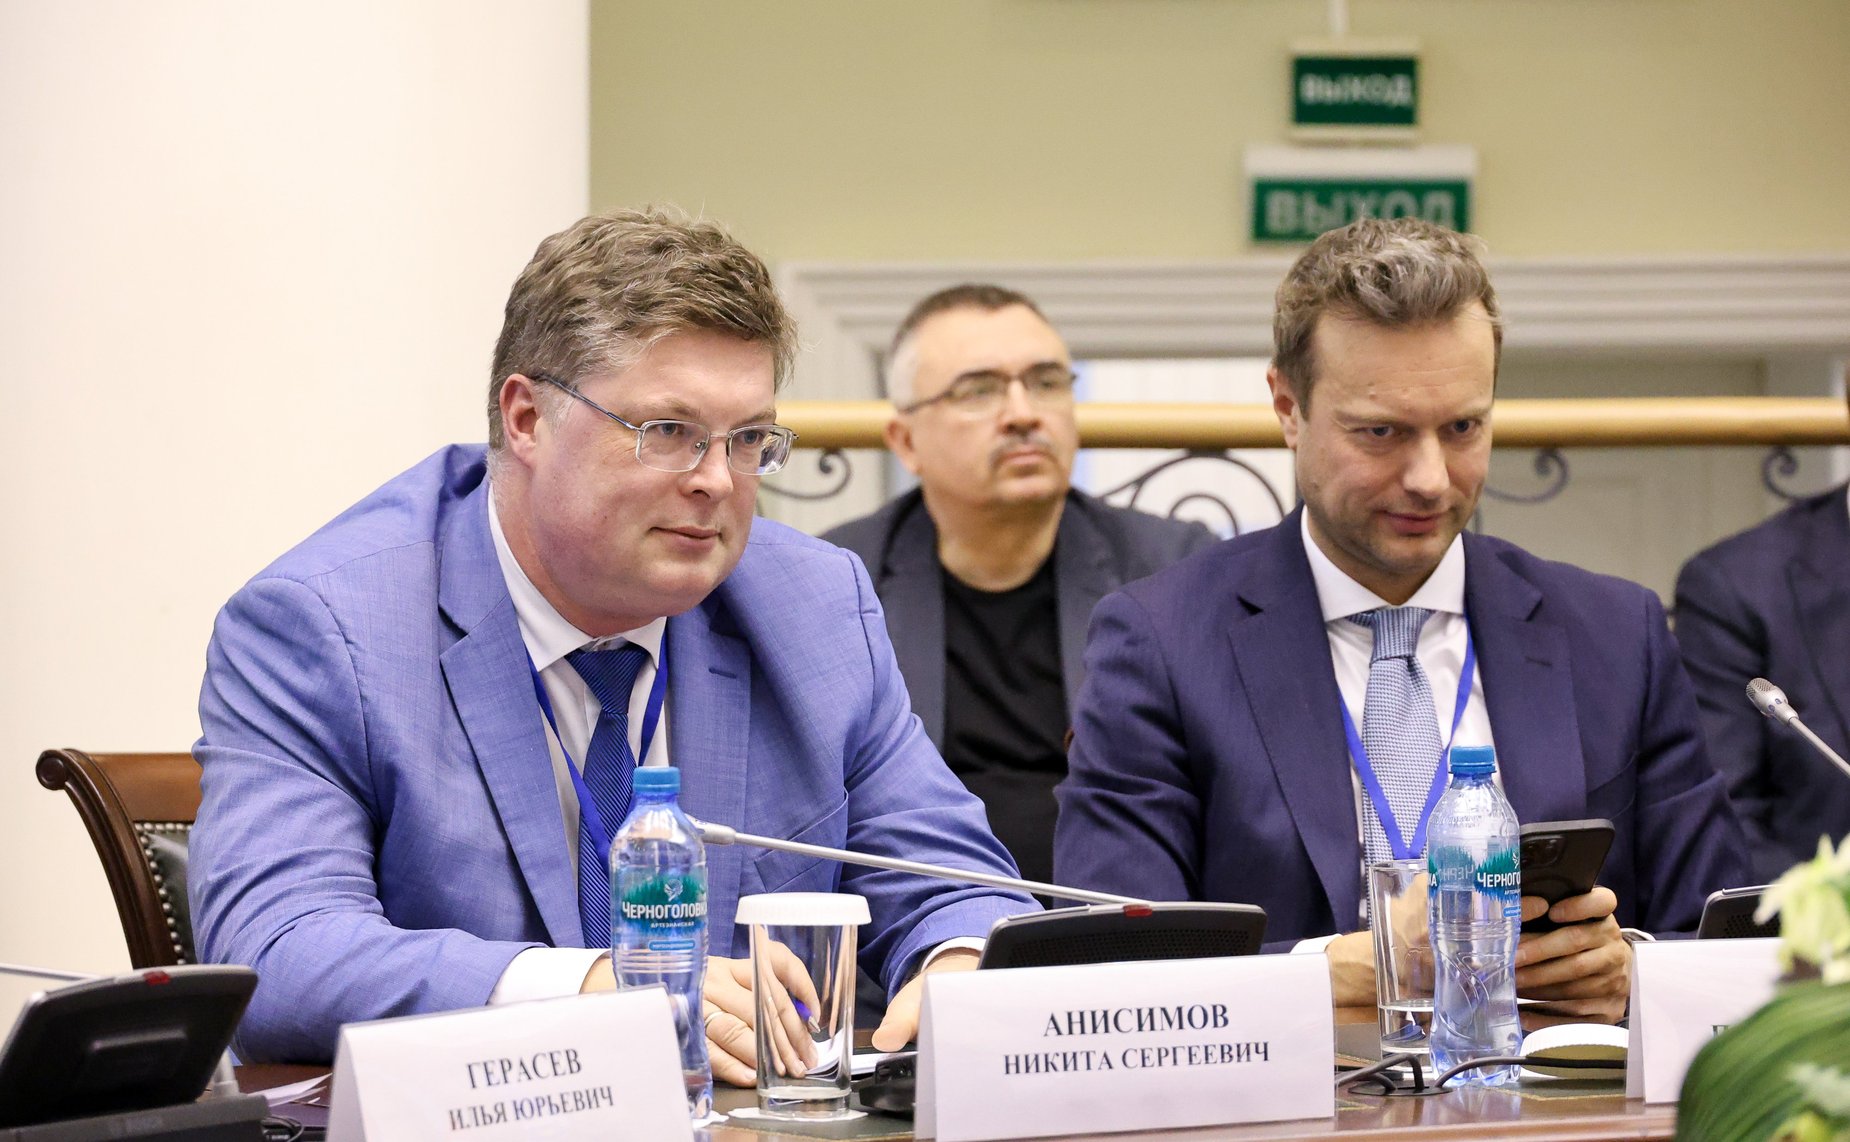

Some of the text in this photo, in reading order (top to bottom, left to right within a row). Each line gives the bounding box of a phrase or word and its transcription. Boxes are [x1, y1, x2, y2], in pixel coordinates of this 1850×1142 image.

[1301, 73, 1413, 107] ВЫХОД
[1043, 1004, 1230, 1037] АНИСИМОВ
[467, 1048, 582, 1089] ГЕРАСЕВ
[1003, 1041, 1270, 1075] НИКИТА СЕРГЕЕВИЧ
[449, 1085, 615, 1131] ИЛЬЯ ЮРЬЕВИЧ
